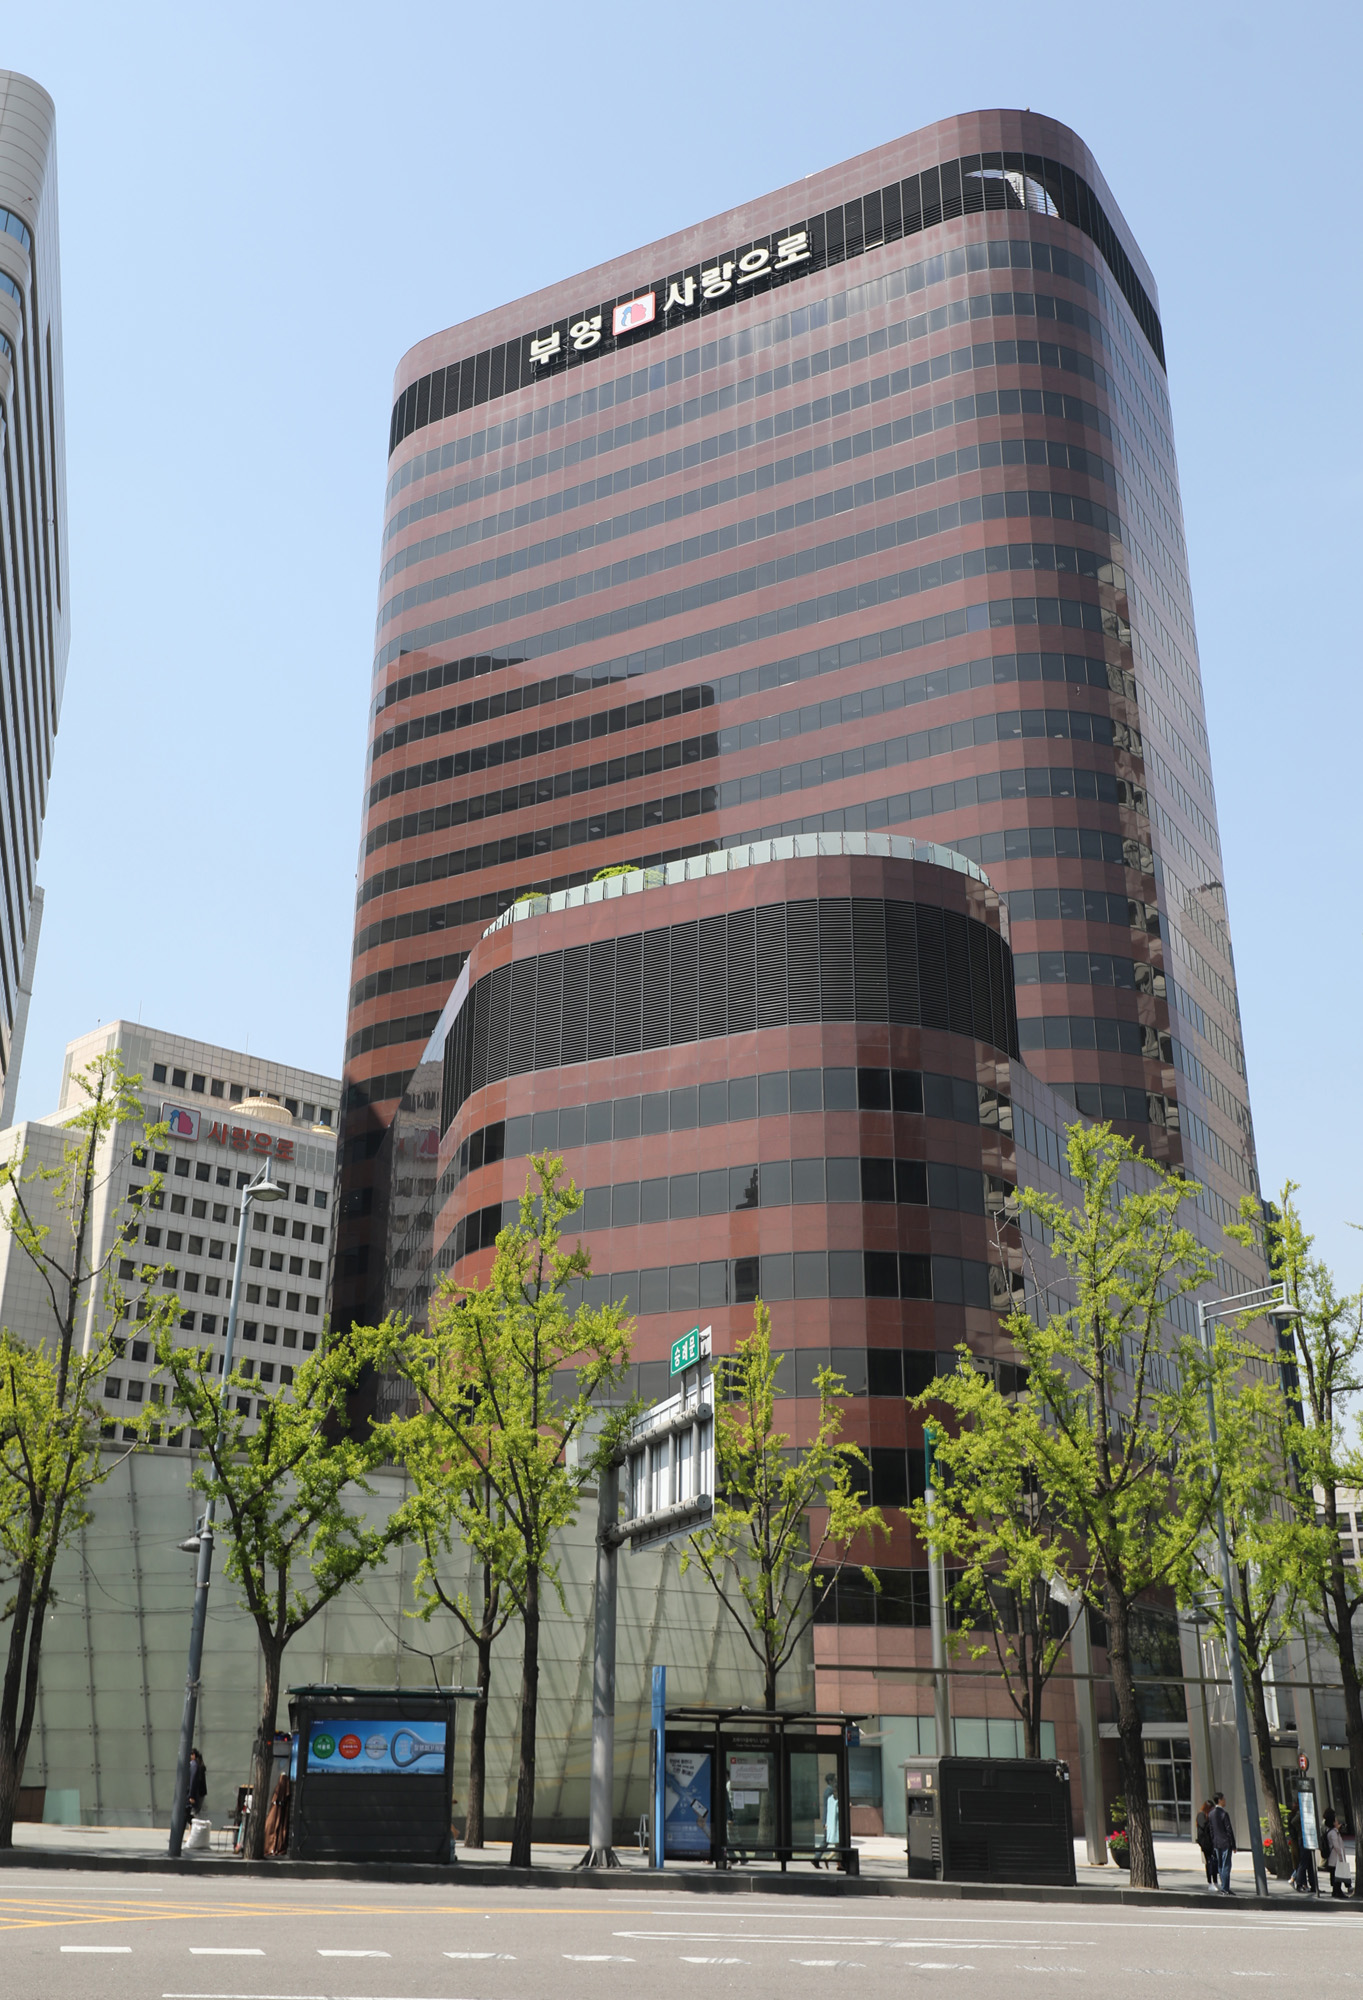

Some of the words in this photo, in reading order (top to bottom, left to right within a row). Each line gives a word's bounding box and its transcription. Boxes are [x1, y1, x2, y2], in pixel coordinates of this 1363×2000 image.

[529, 315, 602, 364] 부영
[663, 231, 811, 311] 사랑으로
[208, 1121, 295, 1160] 사랑으로
[674, 1335, 696, 1367] 숭례문
